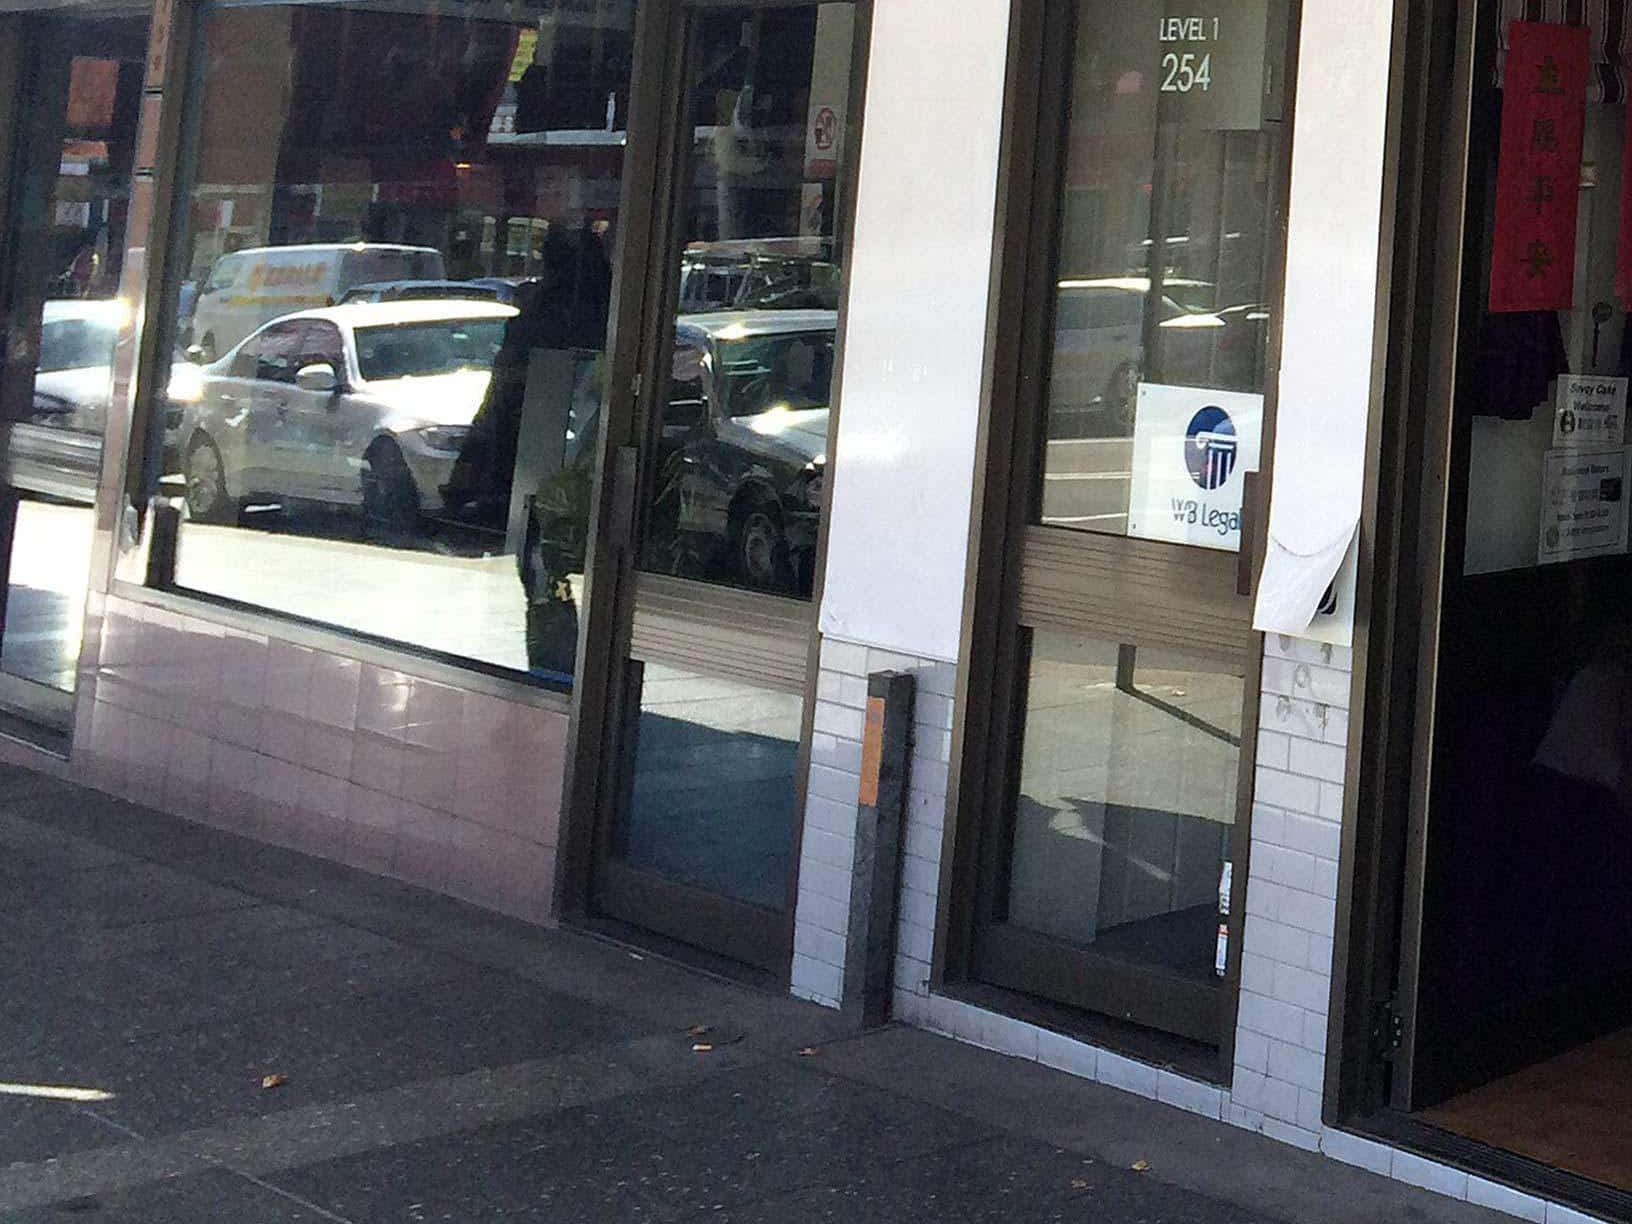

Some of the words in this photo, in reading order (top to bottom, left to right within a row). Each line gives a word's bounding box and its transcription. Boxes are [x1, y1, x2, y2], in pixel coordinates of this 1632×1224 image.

[1160, 18, 1207, 41] LEVEL
[1213, 17, 1219, 41] 1
[1161, 53, 1211, 92] 254
